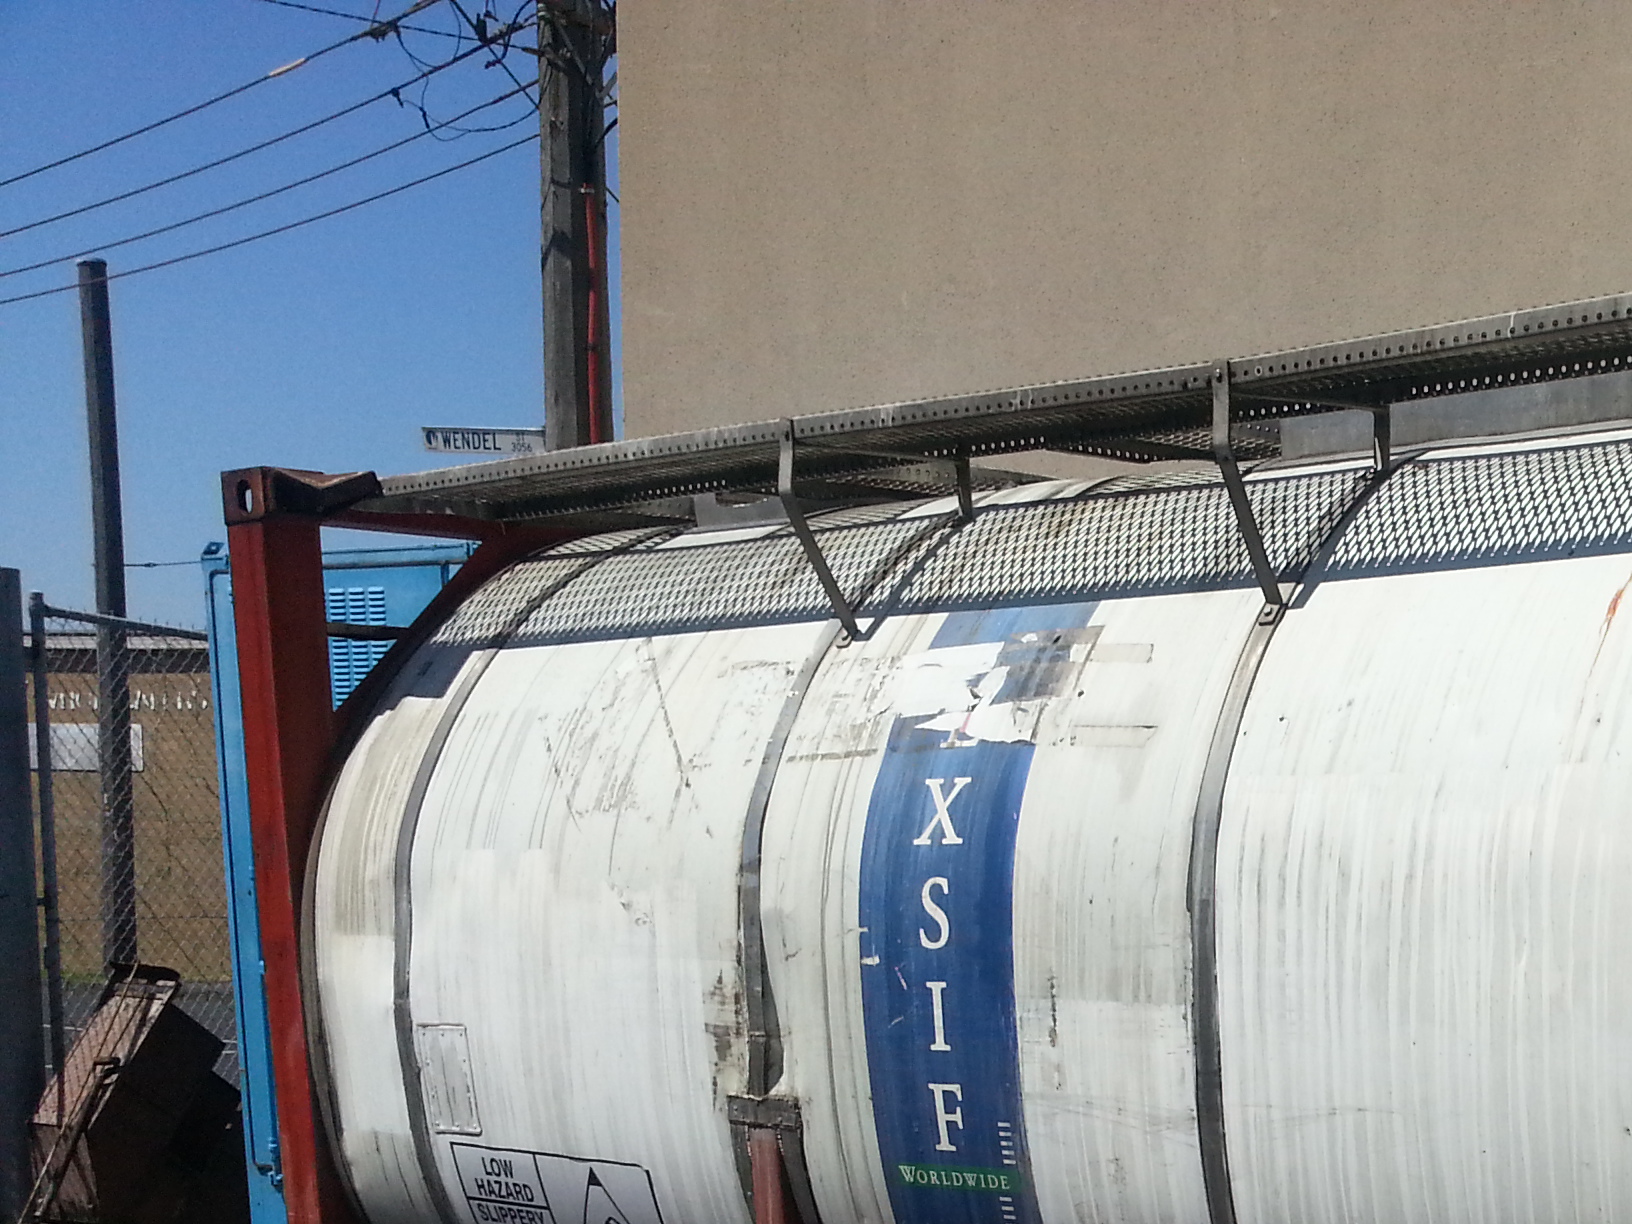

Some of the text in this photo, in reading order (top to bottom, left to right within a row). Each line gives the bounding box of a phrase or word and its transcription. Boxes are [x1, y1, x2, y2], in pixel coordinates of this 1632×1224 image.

[441, 430, 501, 450] WENDEL
[511, 442, 533, 452] 3056
[912, 728, 979, 1151] XSIF
[481, 1156, 513, 1179] LOW
[475, 1177, 535, 1202] HAZARD
